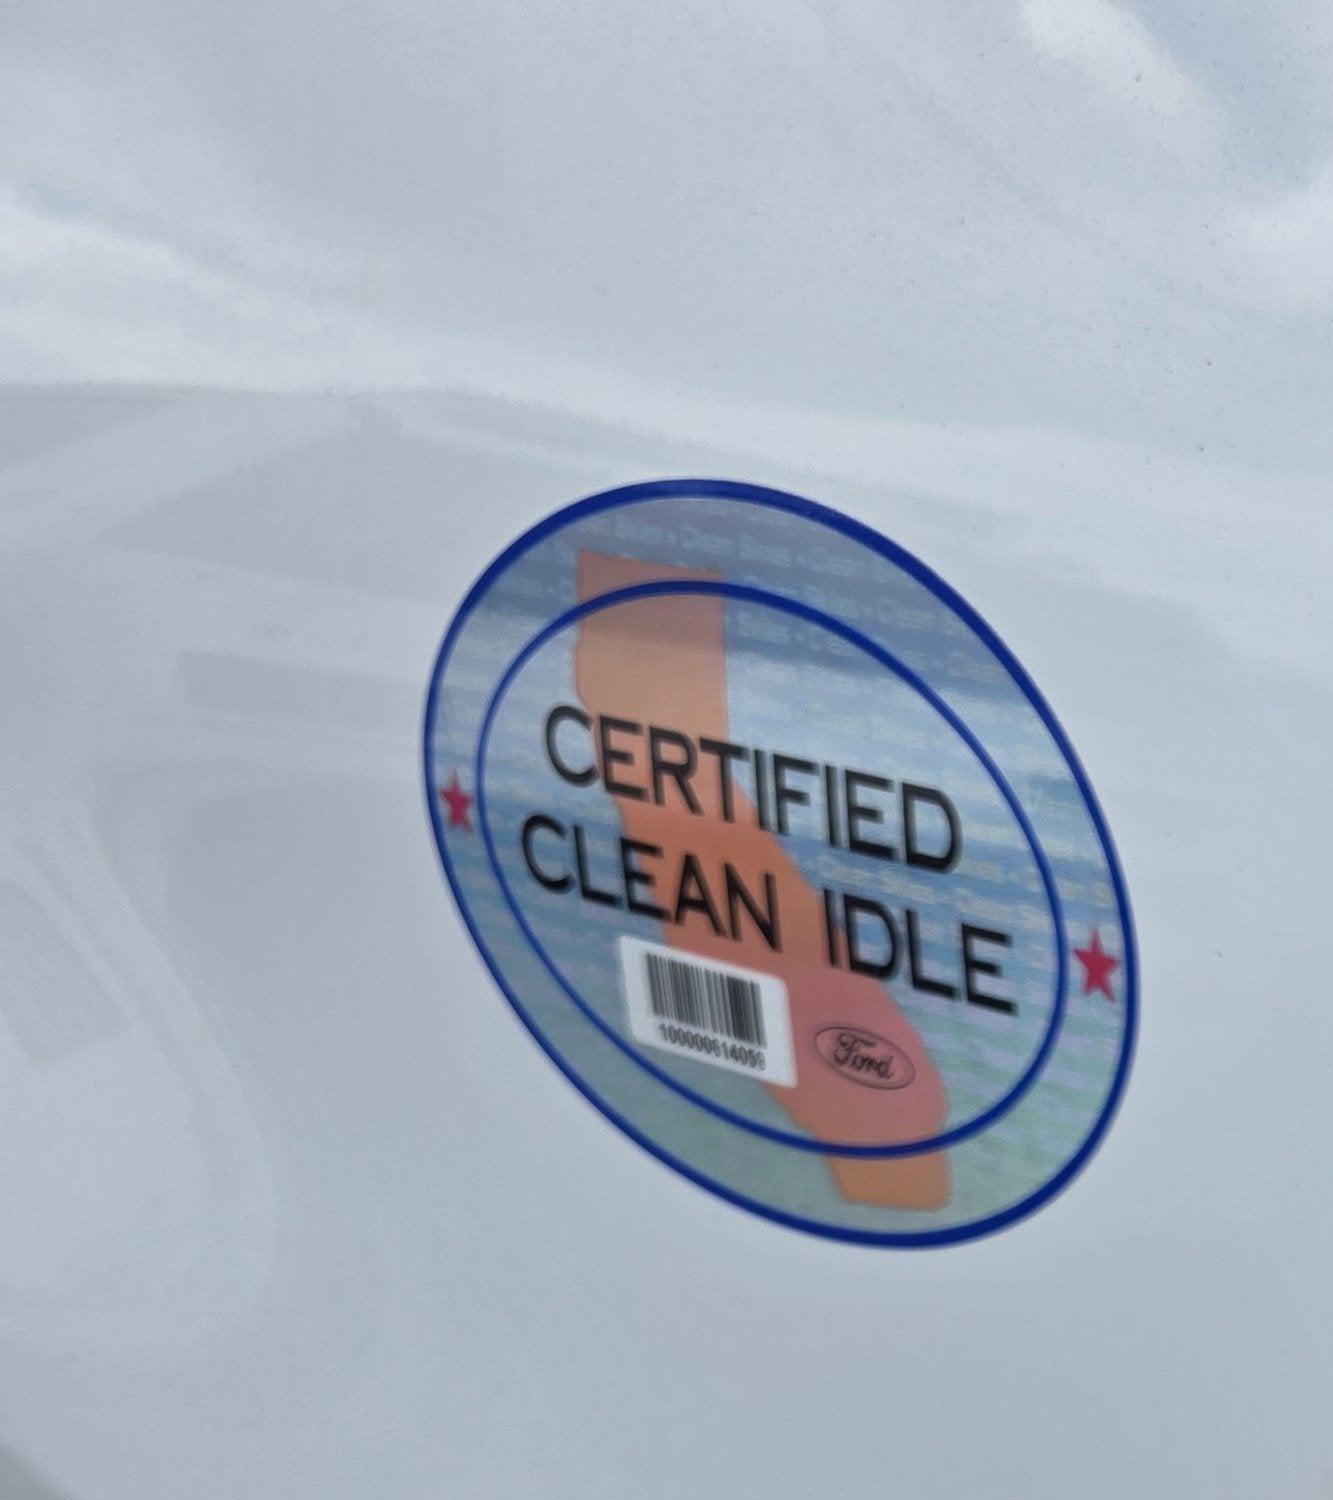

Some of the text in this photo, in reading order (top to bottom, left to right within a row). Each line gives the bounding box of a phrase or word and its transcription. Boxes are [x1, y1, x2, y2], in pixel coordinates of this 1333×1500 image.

[543, 704, 964, 875] CERTIFIED
[520, 814, 1019, 1017] CLEAN IDLE
[834, 1032, 894, 1079] Ford
